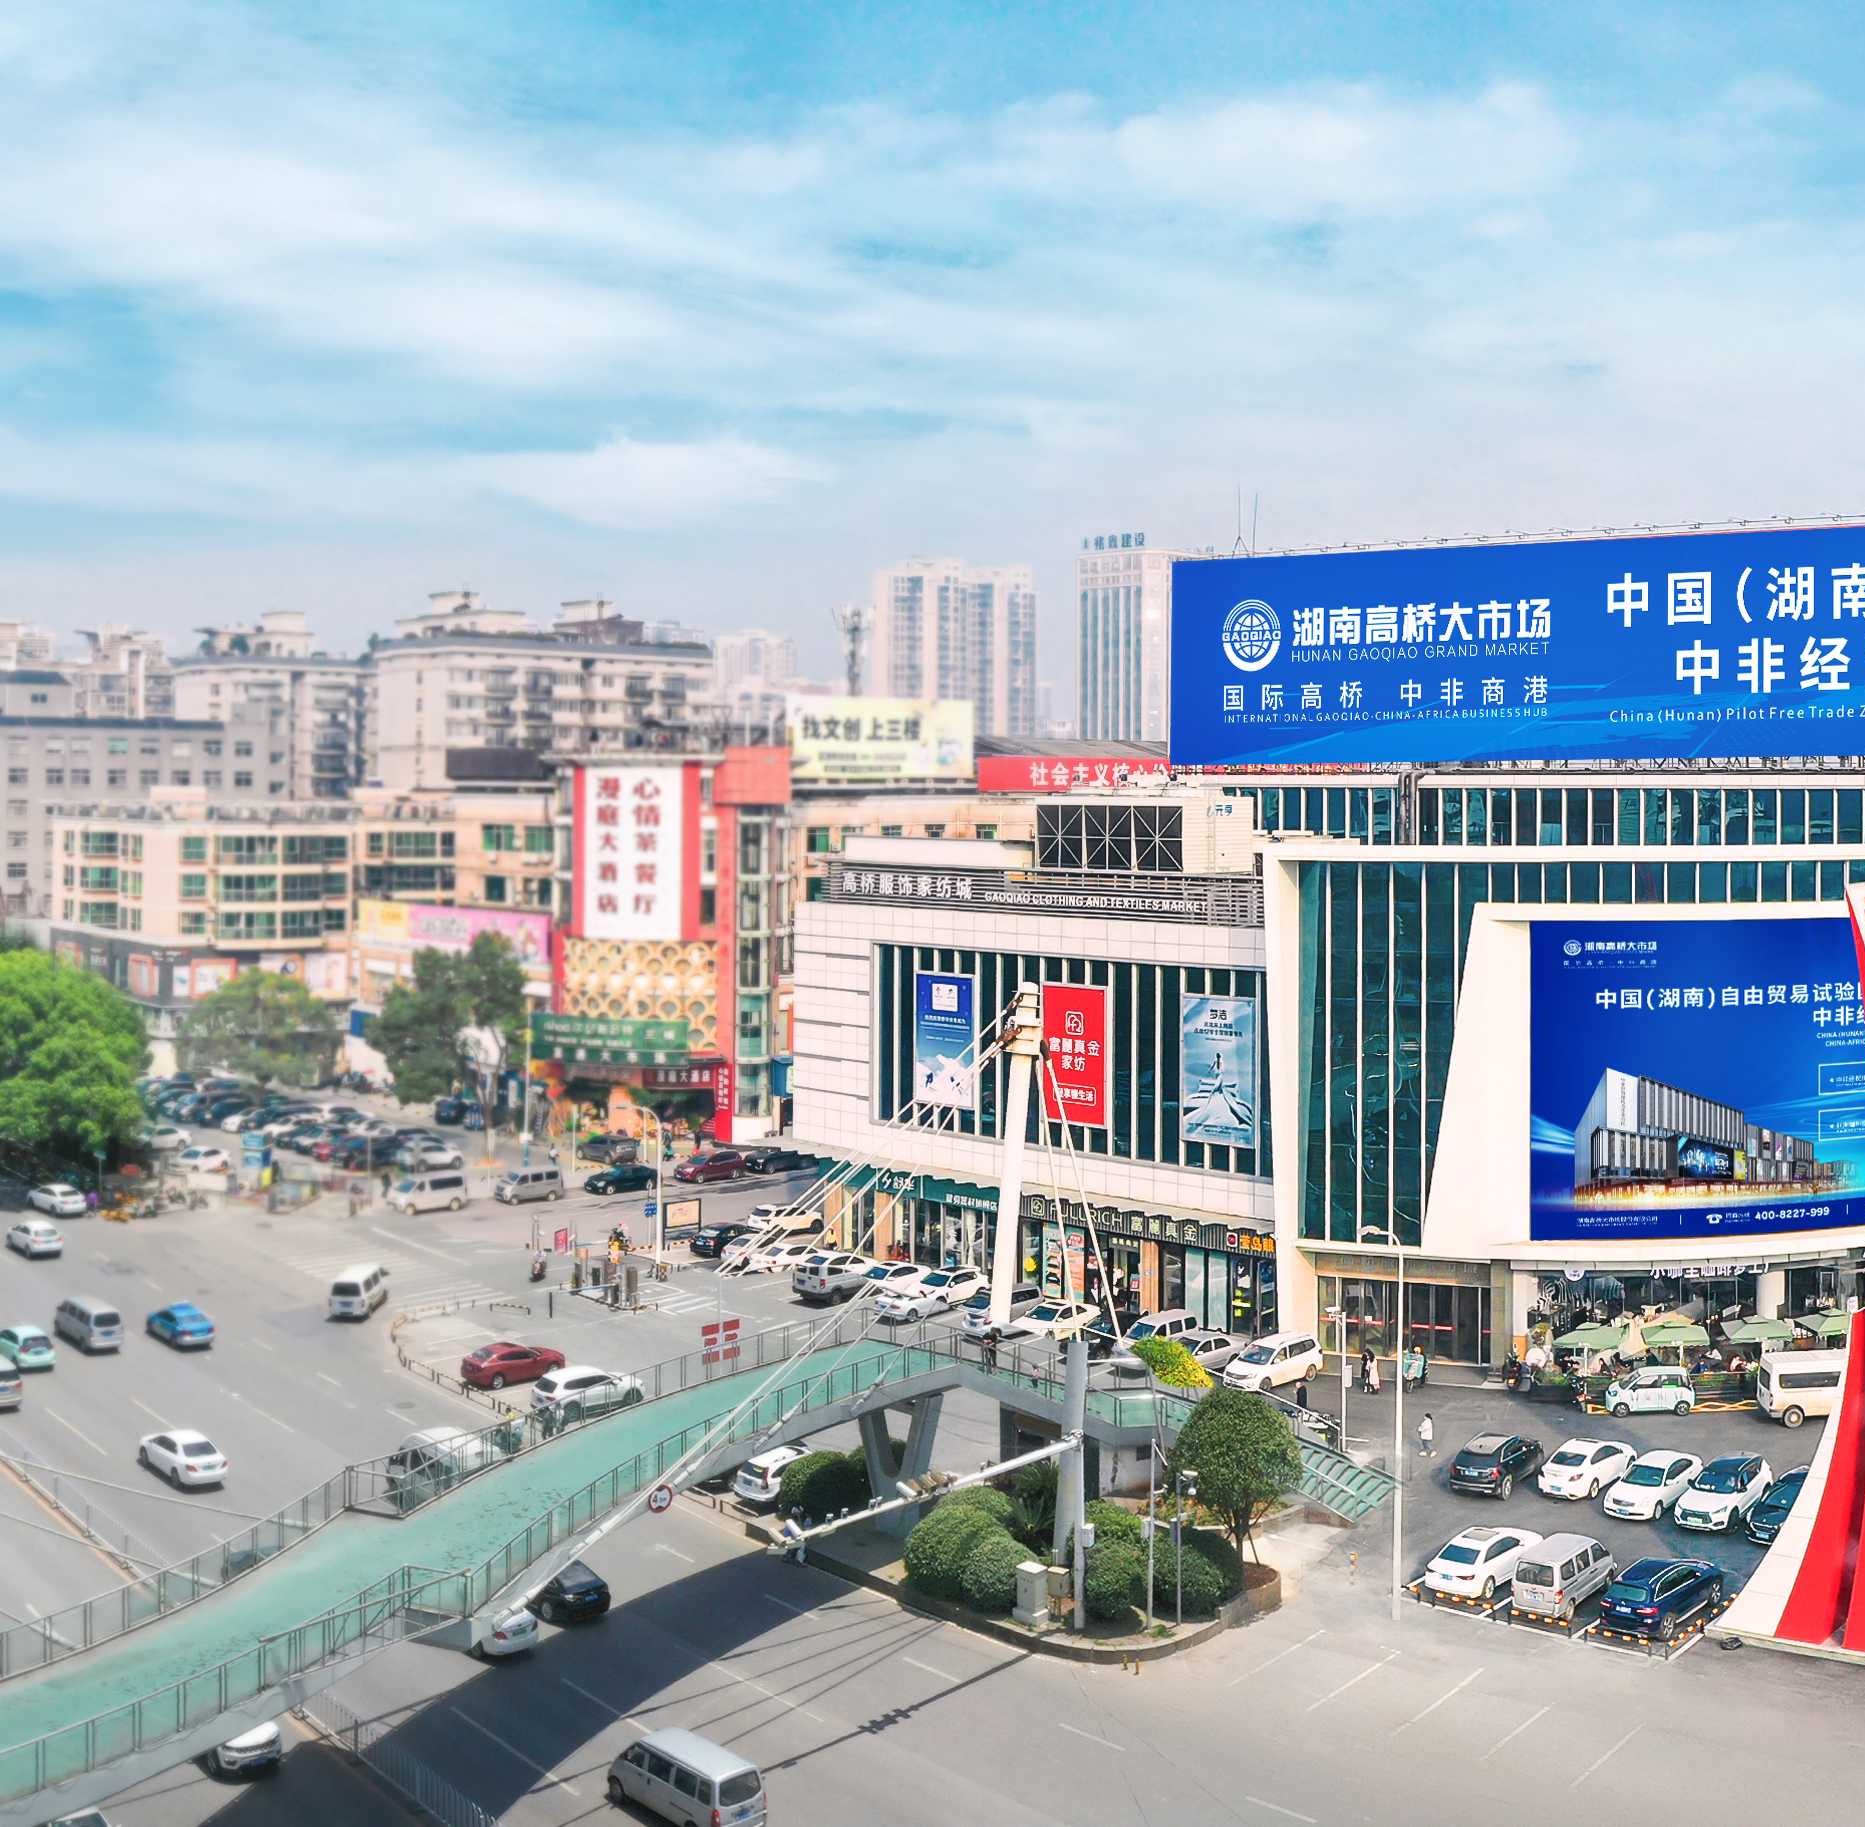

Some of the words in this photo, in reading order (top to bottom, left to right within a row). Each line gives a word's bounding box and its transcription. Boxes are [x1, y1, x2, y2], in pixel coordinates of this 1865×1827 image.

[1292, 599, 1550, 646] 湖南高桥大市场
[1222, 629, 1281, 642] GAOQIAO
[1291, 649, 1342, 663] HUNAN
[1348, 646, 1418, 663] GAOQIAO
[1424, 644, 1478, 659] GRAND
[1485, 641, 1549, 657] MARKET
[1223, 681, 1363, 712] 国际高桥
[1400, 675, 1548, 708] 中非商港
[1523, 707, 1548, 717] HUB
[1609, 709, 1654, 723] China
[1726, 706, 1765, 720] Pilot
[1769, 706, 1805, 719] Free
[1808, 705, 1855, 718] Trade
[842, 871, 972, 900] 高桥服饰家纺城
[984, 891, 1031, 905] GAOQIAO
[1033, 893, 1084, 908] CLOTHING
[1086, 896, 1106, 909] AND
[1109, 897, 1160, 911] TEXTILES
[1161, 900, 1209, 914] MARKET
[1061, 1055, 1086, 1071] 家纺
[1754, 1206, 1831, 1221] 400-8227-999
